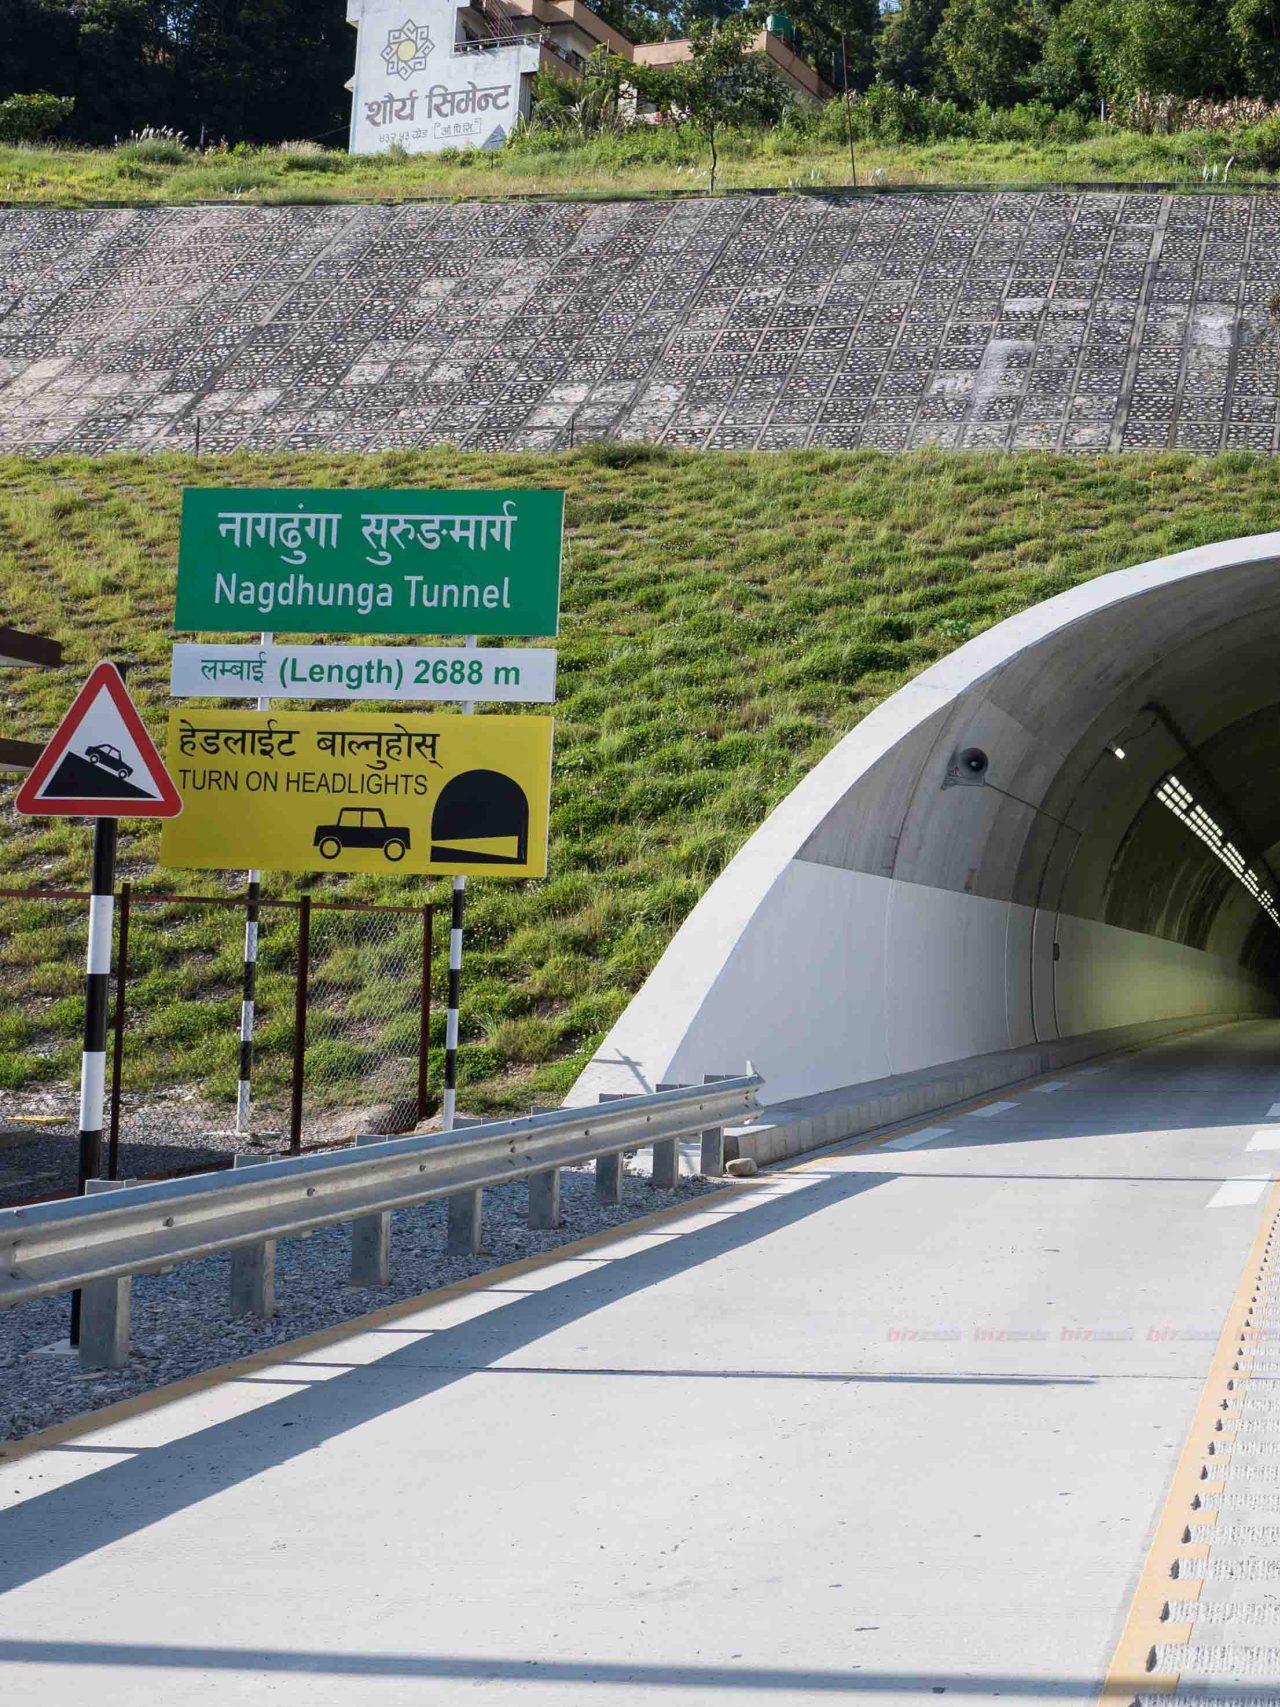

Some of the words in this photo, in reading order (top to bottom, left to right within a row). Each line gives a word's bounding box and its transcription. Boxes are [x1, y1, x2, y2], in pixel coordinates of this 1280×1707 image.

[364, 89, 419, 127] शौर्य
[425, 81, 512, 119] सिमेन्ट
[217, 503, 342, 566] नागढुंगा
[214, 573, 392, 615] Nagdhunga
[404, 575, 511, 609] Tunnel
[201, 651, 267, 684] लम्बाई
[279, 657, 404, 690] (Length)
[414, 659, 483, 685] 2688
[494, 666, 521, 685] m
[179, 719, 300, 757] हेडलाईट
[317, 723, 443, 770] बाल्नुहोस्
[178, 770, 238, 791] TURN
[246, 771, 278, 792] ON
[285, 772, 428, 796] HEADLIGHTS
